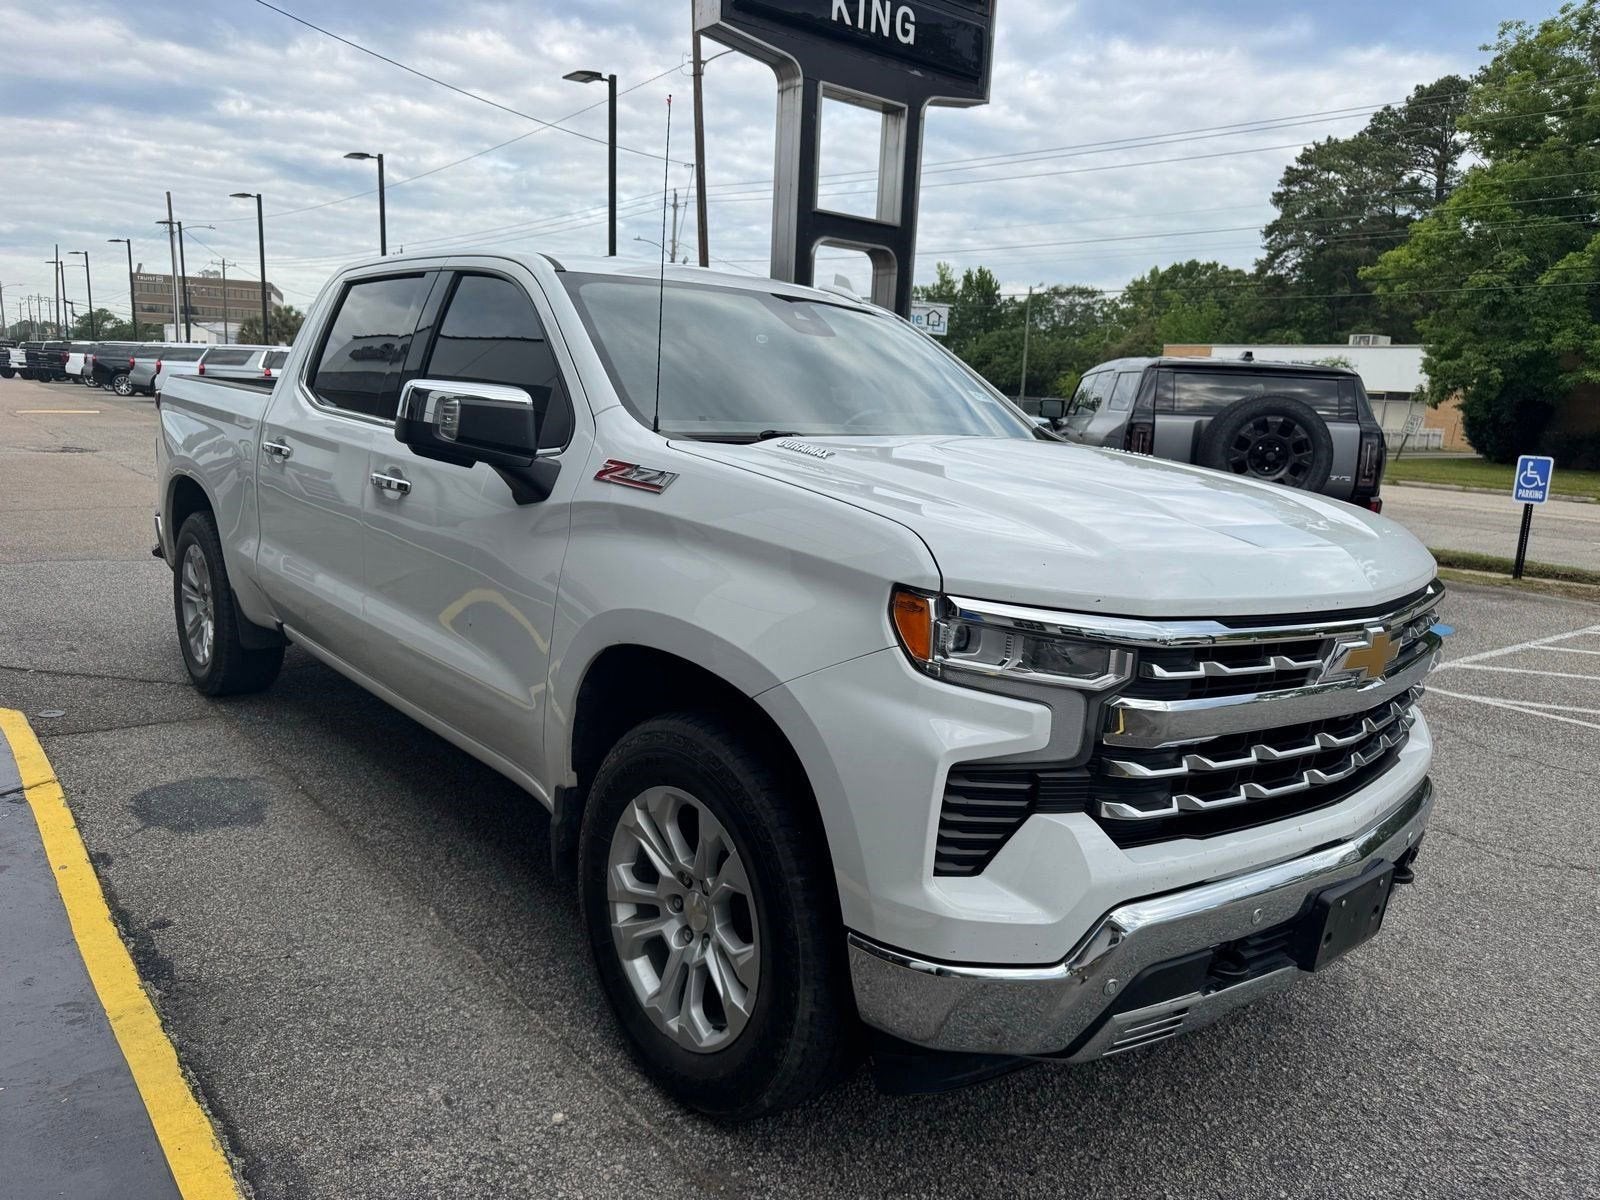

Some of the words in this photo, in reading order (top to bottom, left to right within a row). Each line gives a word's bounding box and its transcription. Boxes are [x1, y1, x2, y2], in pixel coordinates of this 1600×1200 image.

[831, 0, 916, 46] KING
[593, 458, 680, 494] Z71
[1517, 488, 1544, 500] PARKING
